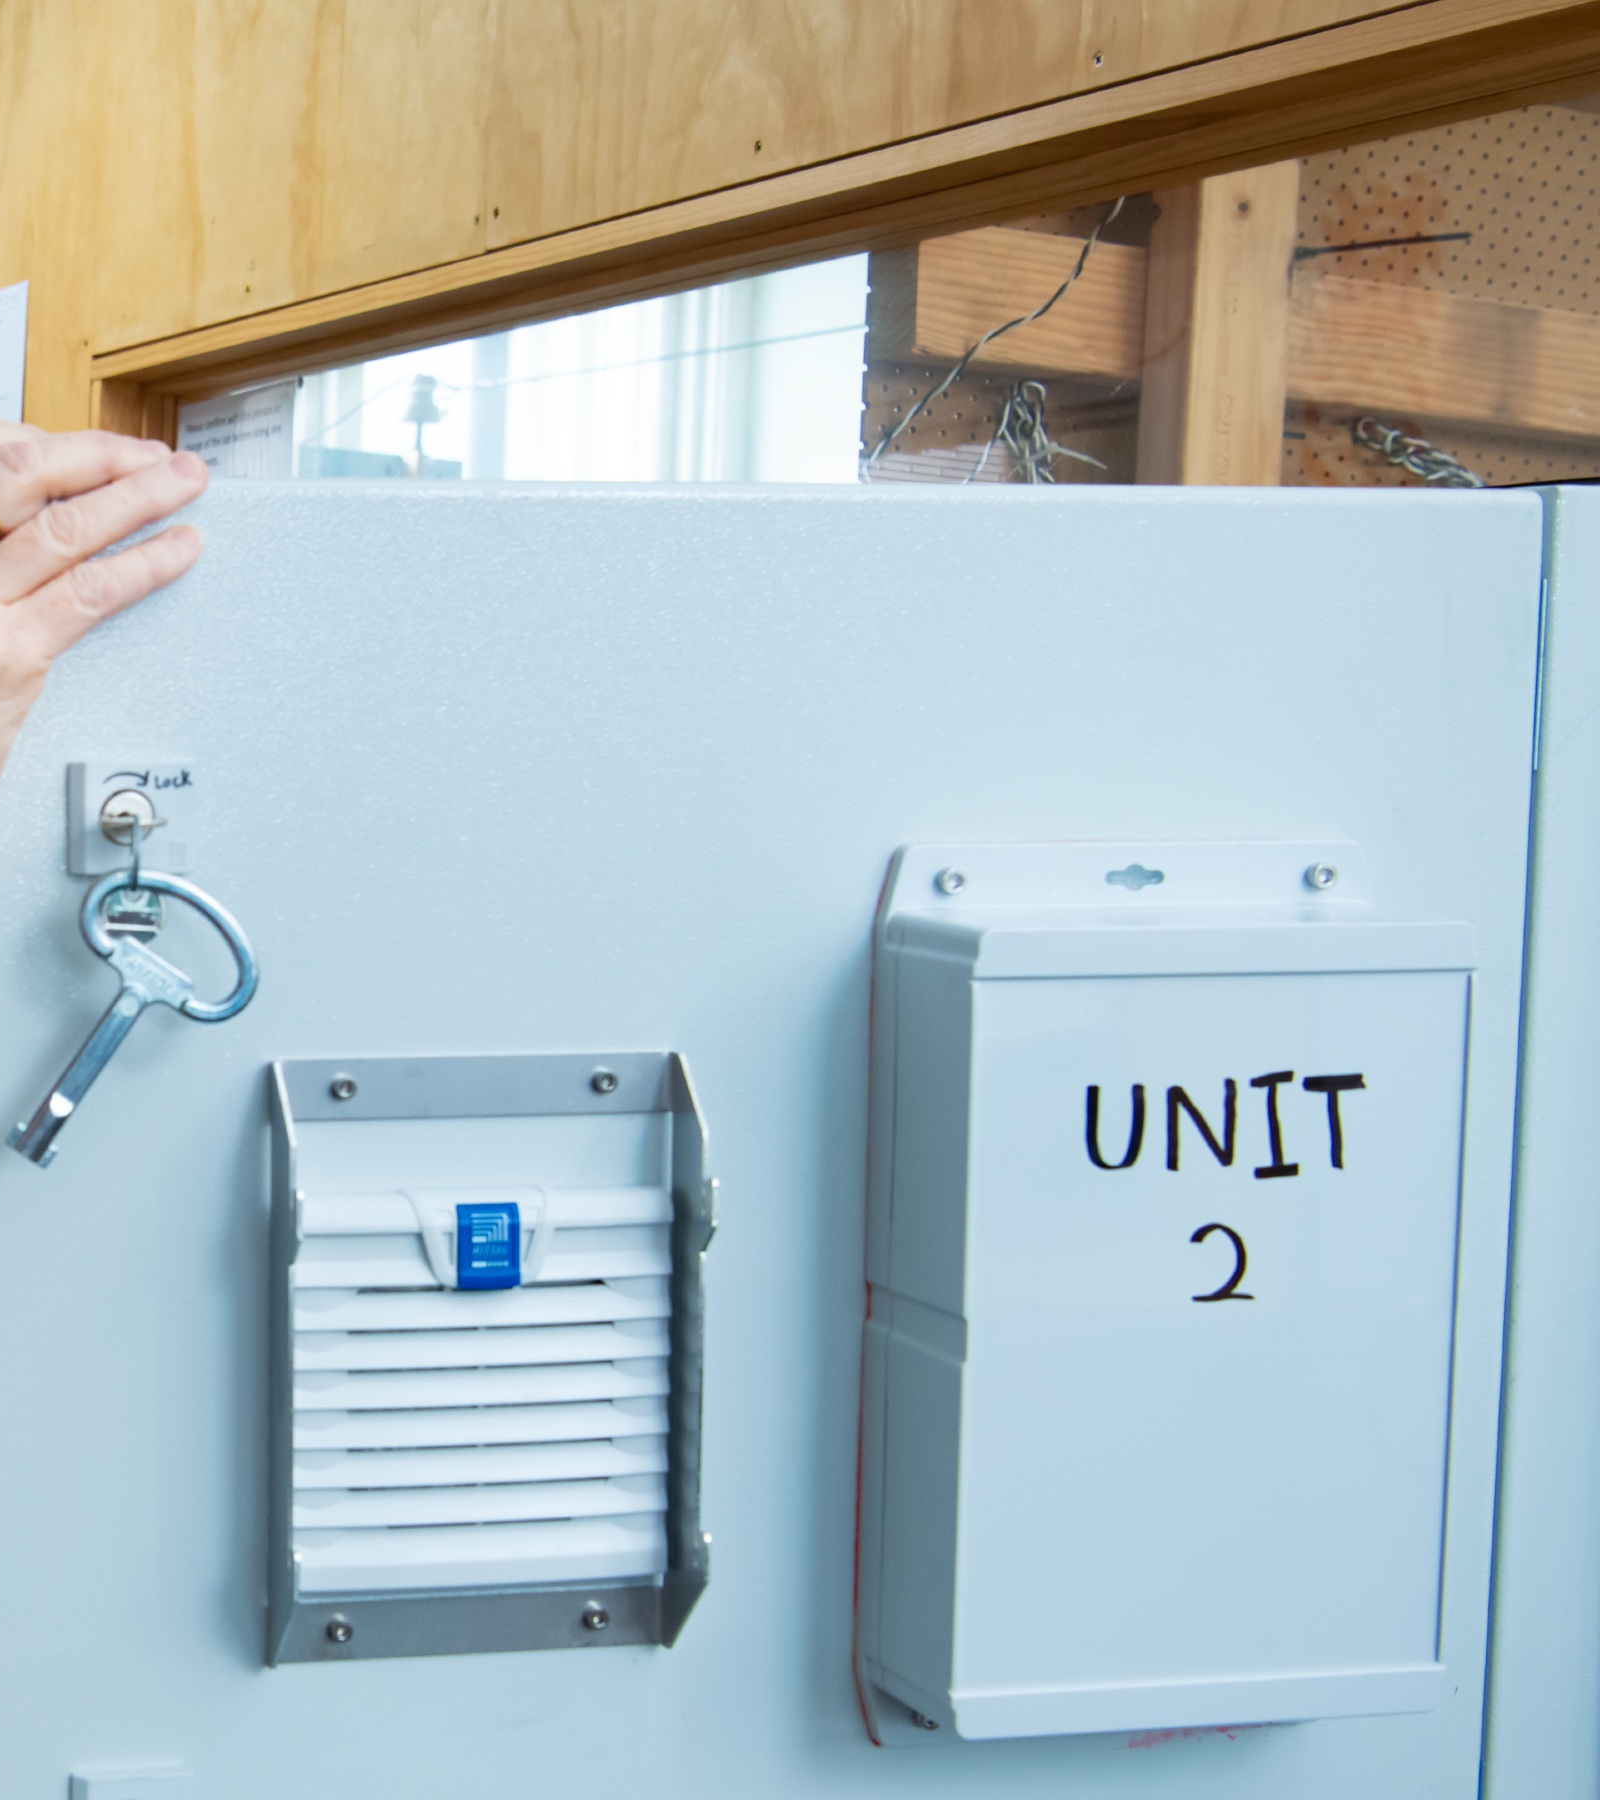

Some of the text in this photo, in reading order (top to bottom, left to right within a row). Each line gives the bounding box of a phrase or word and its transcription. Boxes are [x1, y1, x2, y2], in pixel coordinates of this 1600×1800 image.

[154, 768, 193, 789] Lock
[1085, 1069, 1367, 1179] UNIT
[1189, 1222, 1255, 1302] 2
